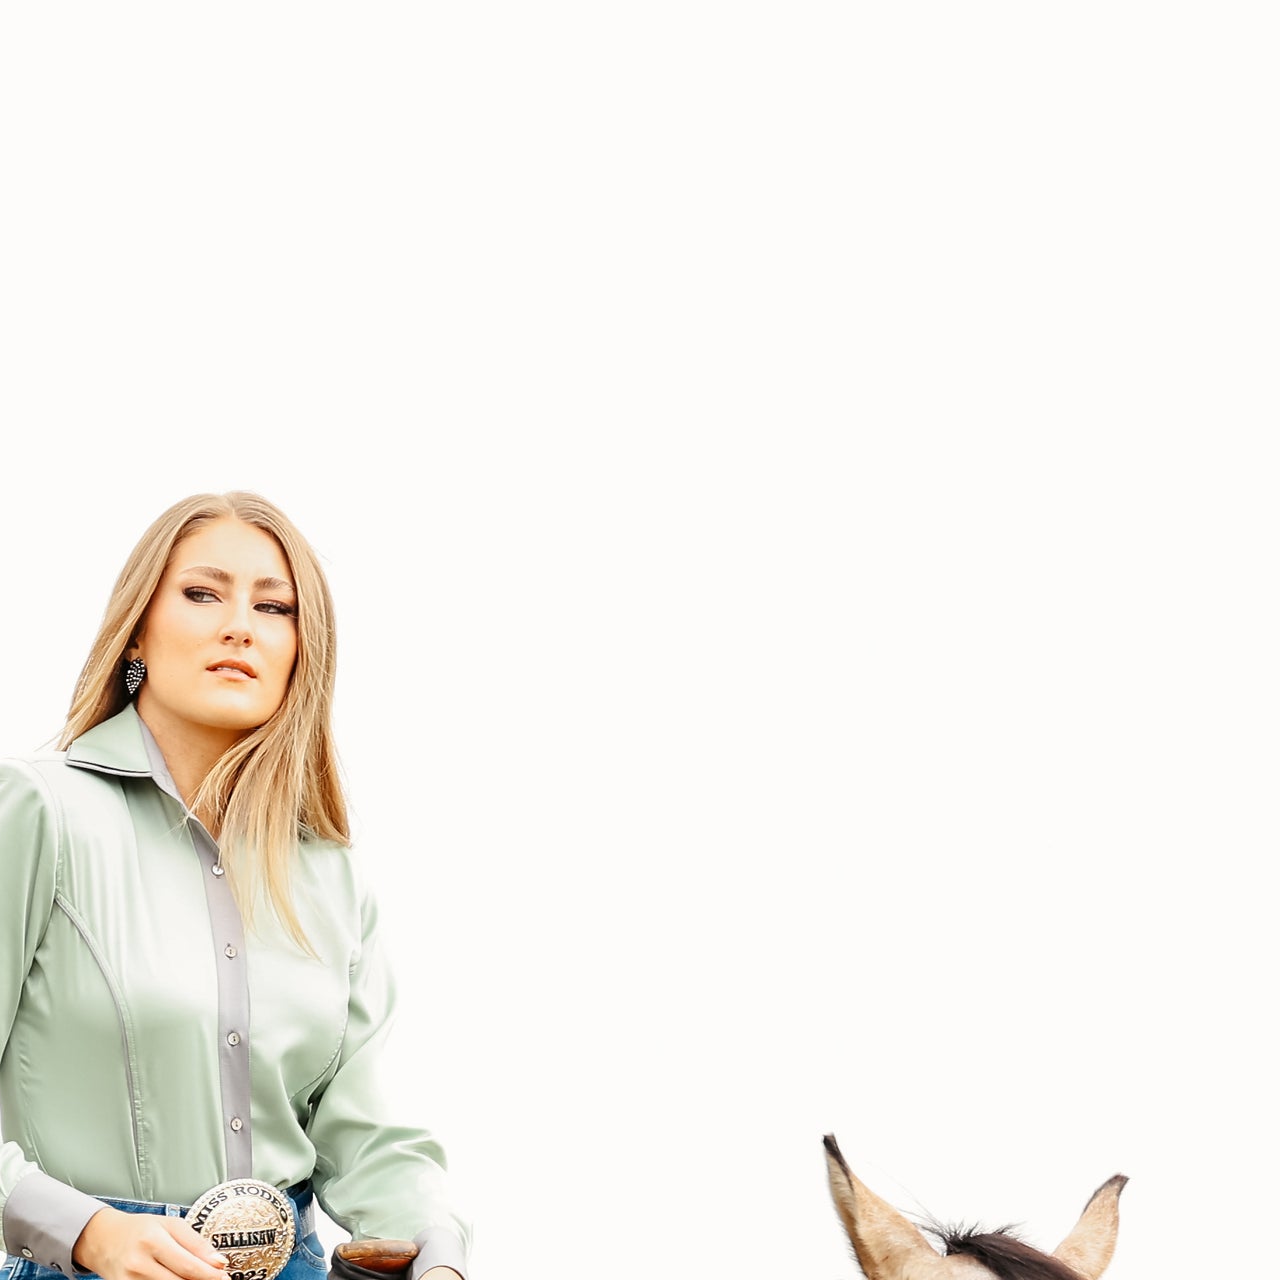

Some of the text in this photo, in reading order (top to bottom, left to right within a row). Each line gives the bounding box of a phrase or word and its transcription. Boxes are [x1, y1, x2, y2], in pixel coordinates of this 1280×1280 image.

[192, 1186, 288, 1234] MISS RODEO
[211, 1228, 277, 1249] SALLISAW
